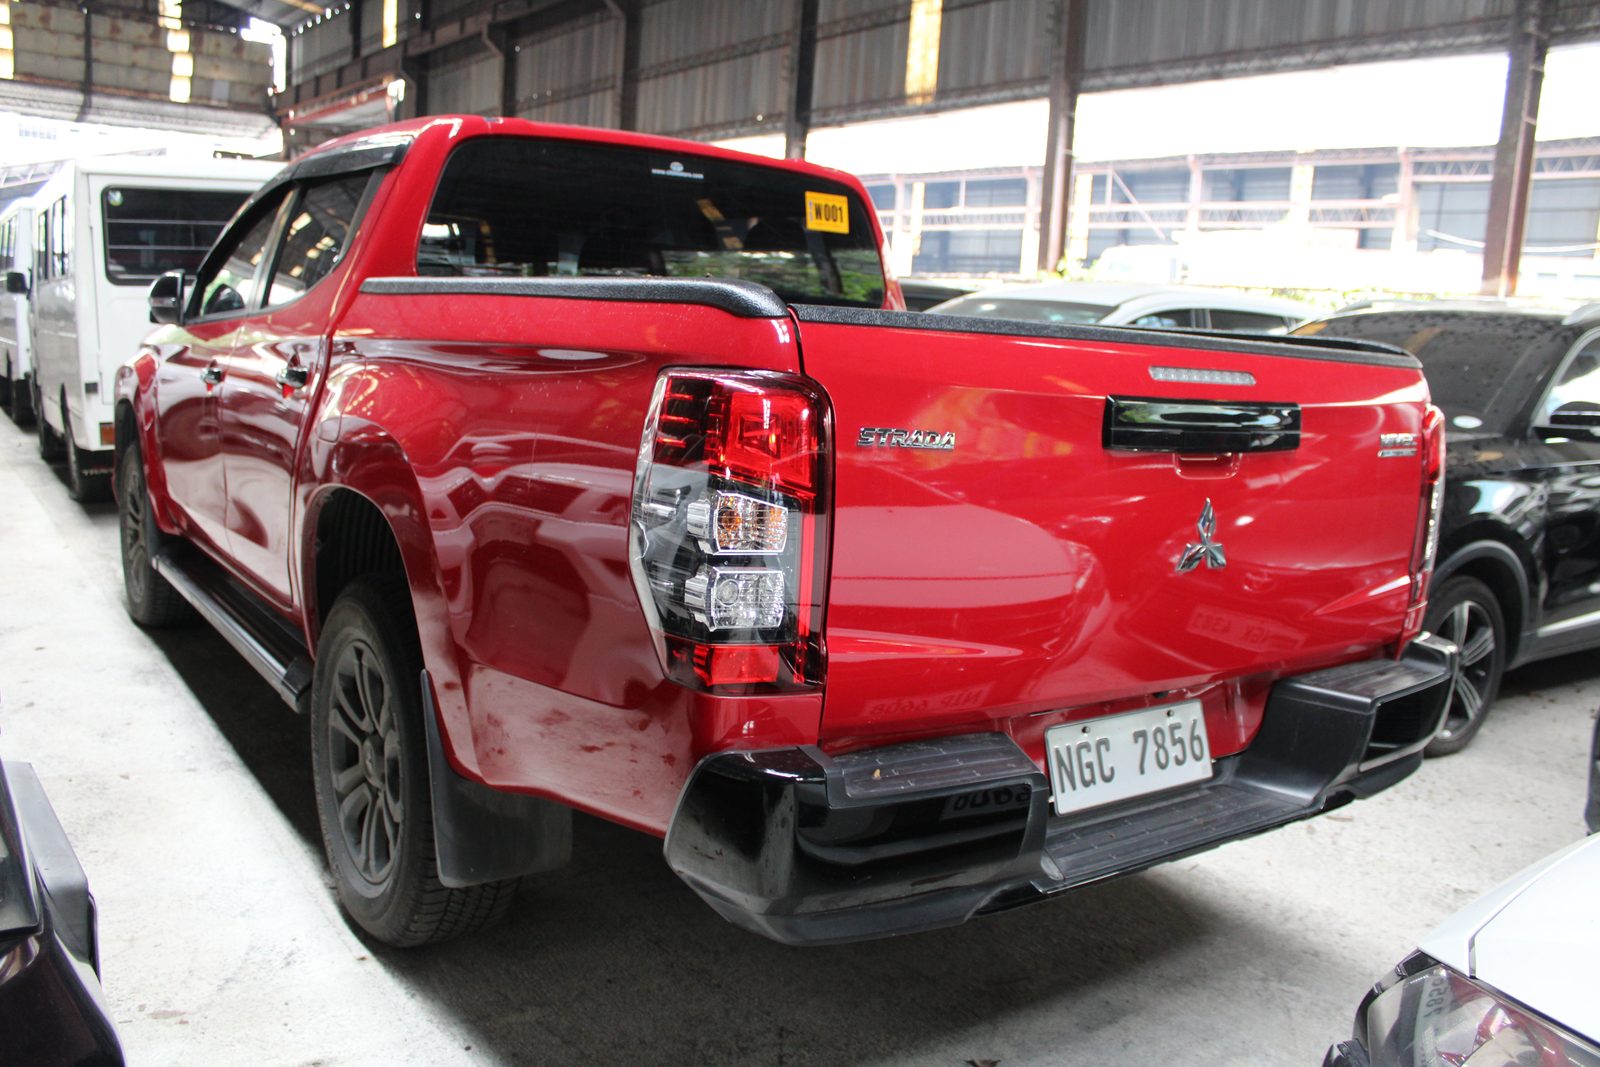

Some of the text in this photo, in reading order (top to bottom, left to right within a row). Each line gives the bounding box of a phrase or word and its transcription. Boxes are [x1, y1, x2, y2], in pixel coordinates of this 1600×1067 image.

[813, 202, 844, 223] W001
[857, 427, 956, 450] STRADA
[1054, 719, 1204, 793] NGC 7856
